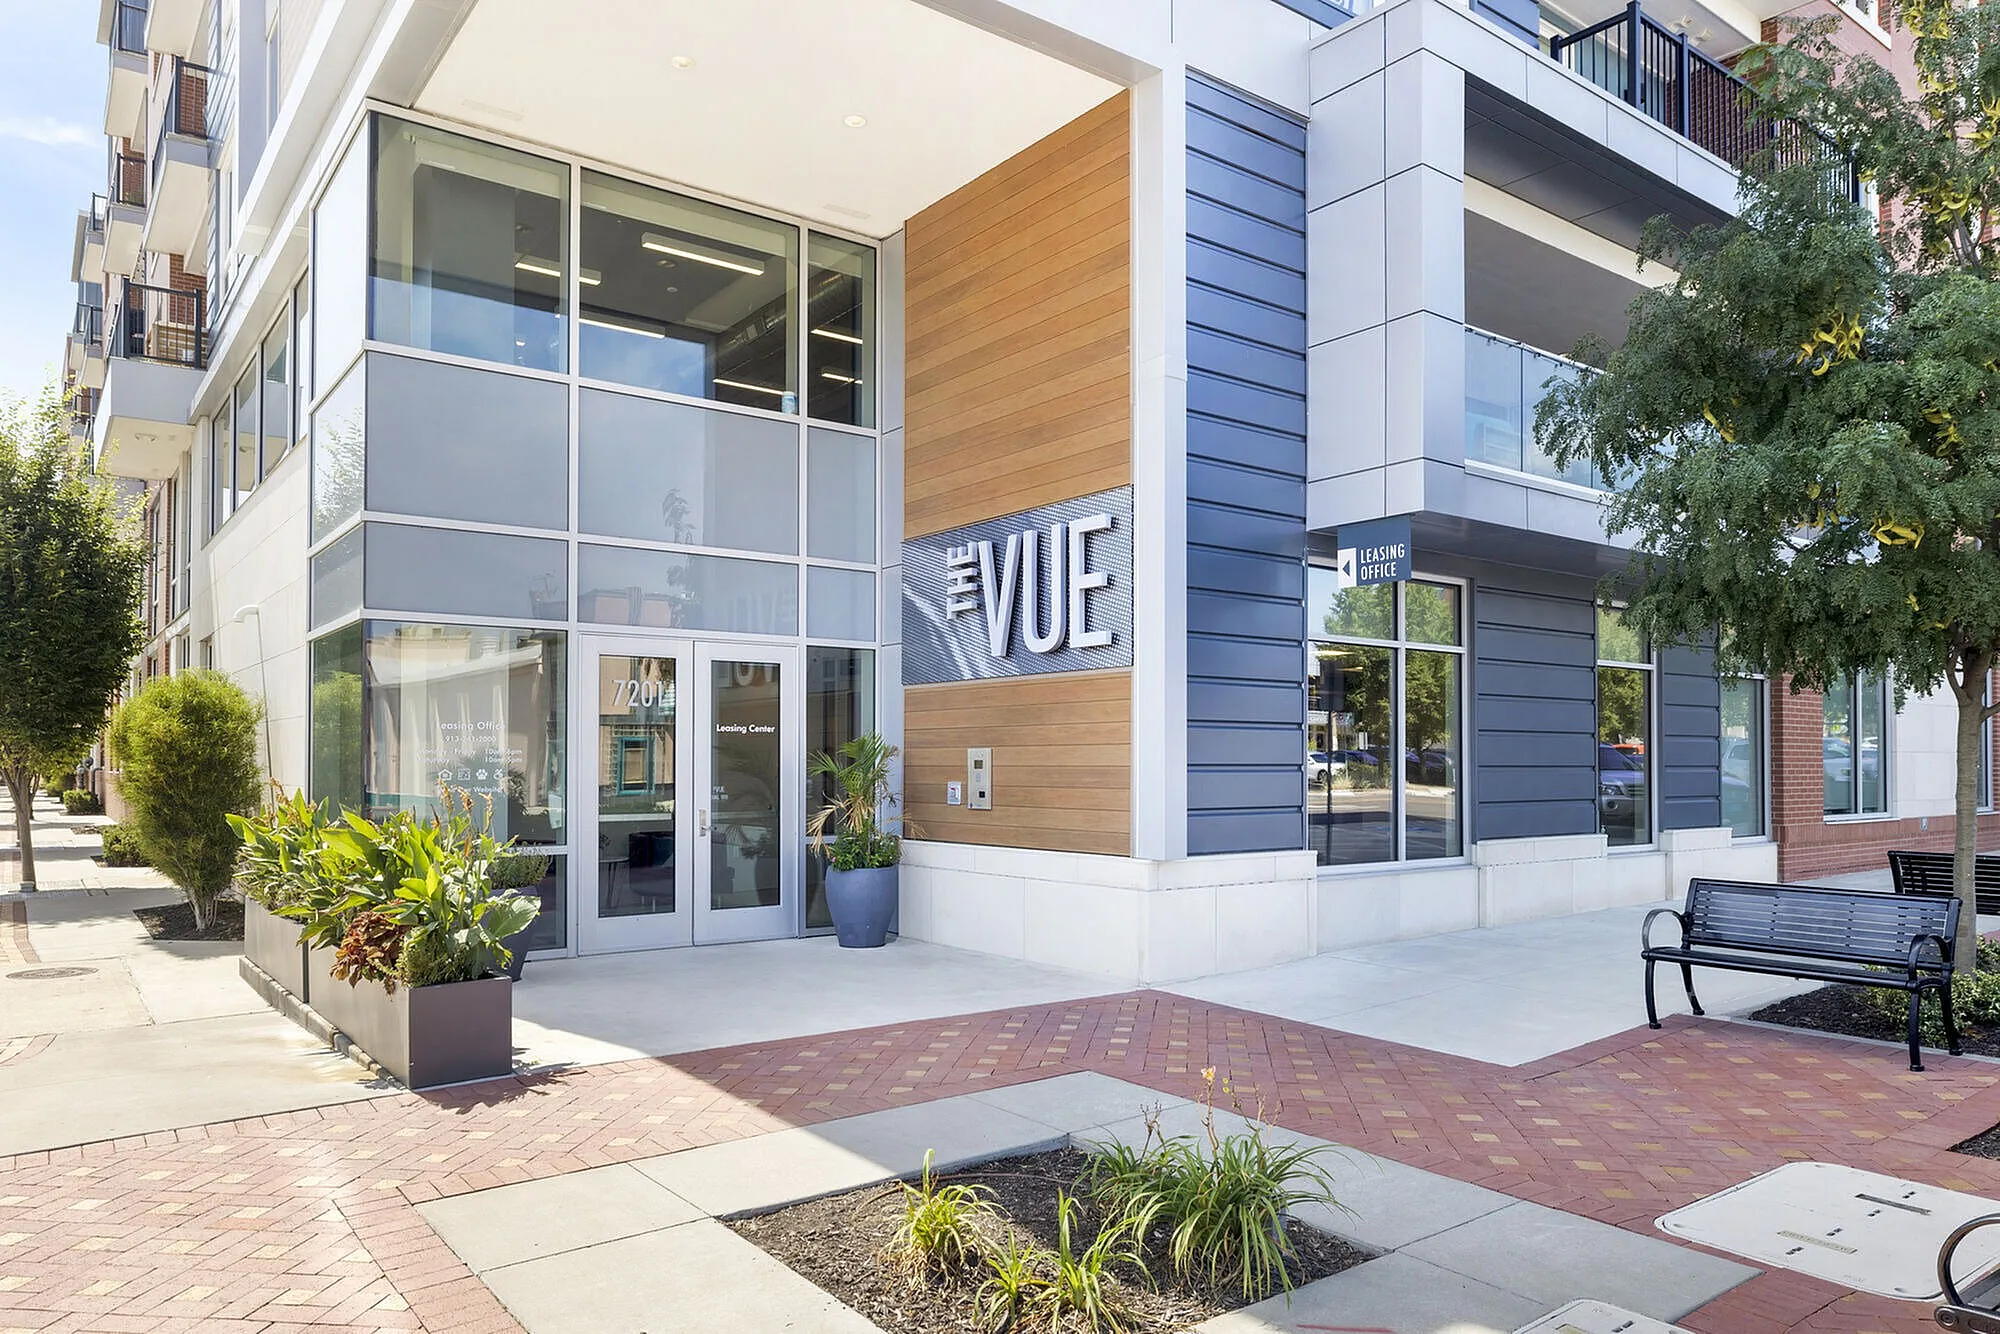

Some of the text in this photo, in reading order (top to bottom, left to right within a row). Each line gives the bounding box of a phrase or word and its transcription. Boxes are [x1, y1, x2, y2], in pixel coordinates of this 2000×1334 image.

[1360, 543, 1405, 564] LEASING
[1360, 561, 1397, 581] OFFICE
[946, 513, 1114, 658] THE VUE
[612, 679, 663, 708] 7201
[716, 723, 776, 734] Leasing Center
